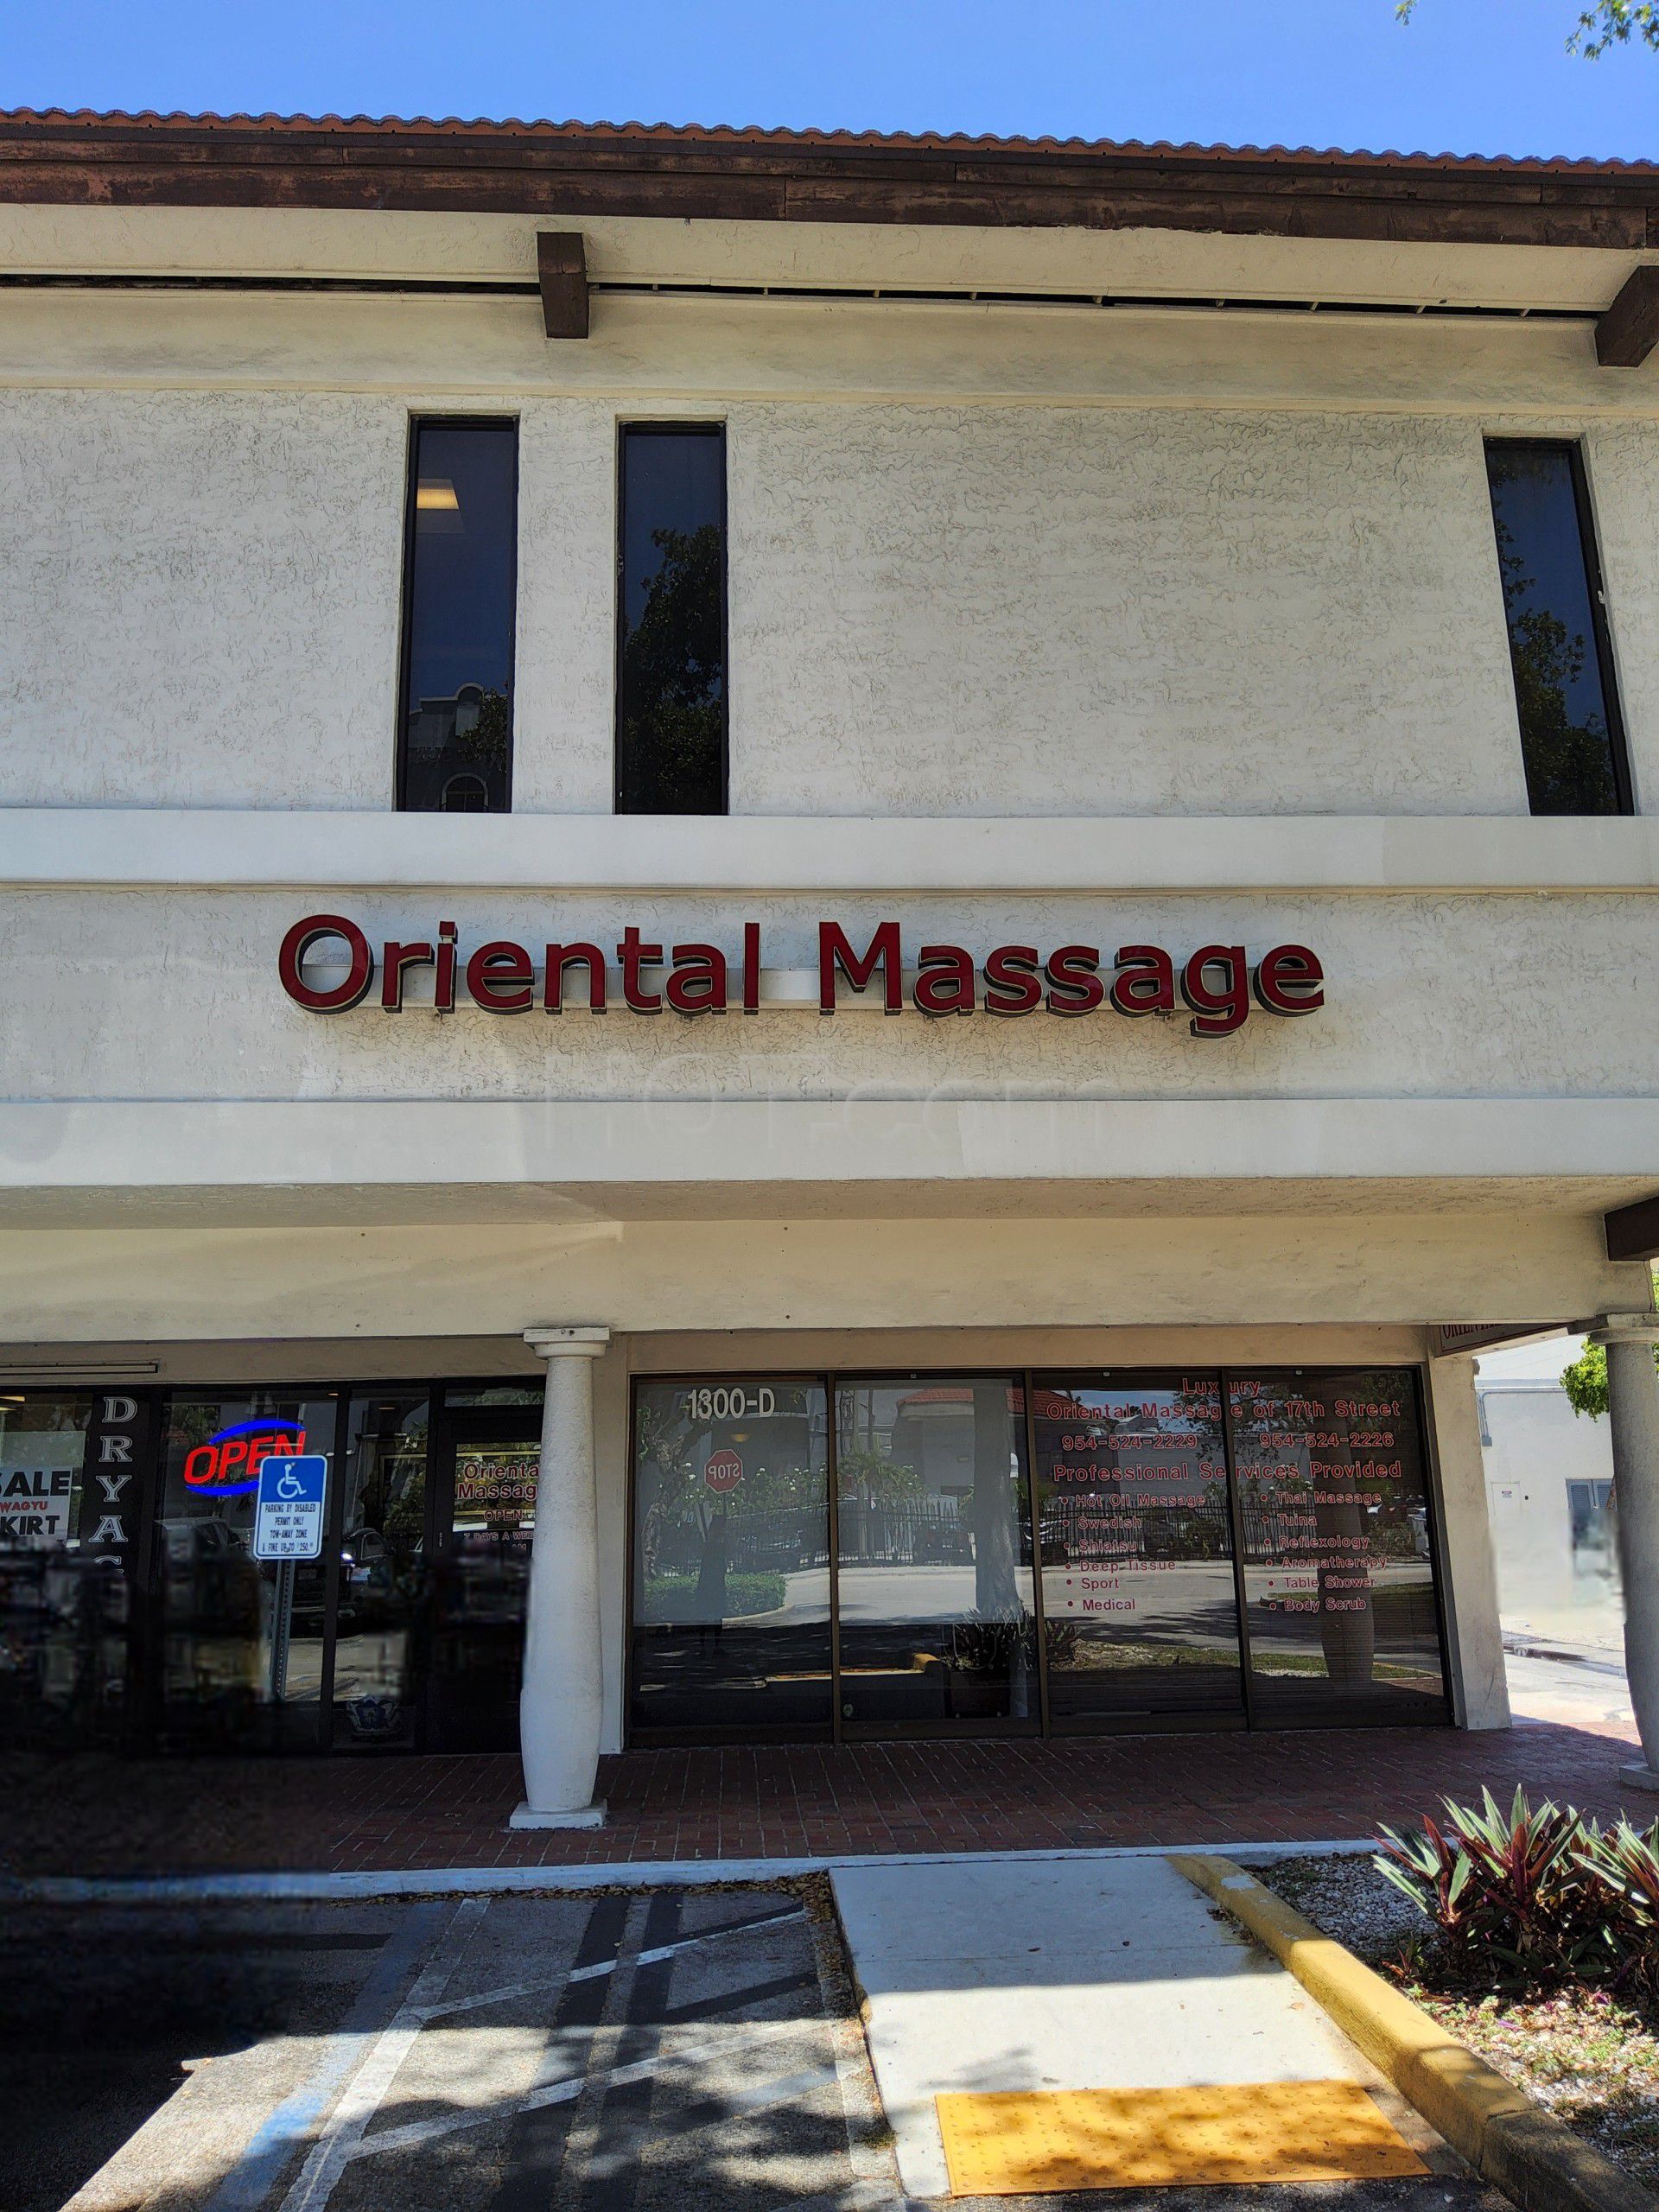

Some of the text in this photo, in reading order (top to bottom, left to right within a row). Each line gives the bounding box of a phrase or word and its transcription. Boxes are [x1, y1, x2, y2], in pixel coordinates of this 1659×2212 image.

[278, 914, 1325, 1038] Oriental Massage
[688, 1388, 775, 1419] 1300-D
[1046, 1402, 1132, 1420] Oriental
[1253, 1401, 1275, 1418] of
[1284, 1400, 1325, 1417] 17th
[1334, 1400, 1401, 1417] Street
[1061, 1433, 1198, 1452] 954-524-2229
[1259, 1432, 1395, 1448] 954-524-2226
[184, 1431, 306, 1484] OPEN
[464, 1463, 539, 1479] Orienta
[1053, 1463, 1189, 1482] Professional
[1309, 1460, 1402, 1478] Provided
[0, 1471, 71, 1497] ALE
[457, 1482, 537, 1501] Massag
[1275, 1491, 1382, 1505] Thai Massage
[1075, 1493, 1206, 1508] Hot Oil Massage
[265, 1503, 284, 1513] PARKING
[295, 1503, 316, 1513] DISABLED
[484, 1509, 524, 1521] OPEN
[275, 1516, 304, 1526] PERMIT ONLY
[1077, 1516, 1142, 1529] Swedish
[1277, 1513, 1318, 1526] Tuina
[296, 1529, 308, 1538] ZONE
[473, 1531, 499, 1541] DAYS
[502, 1531, 510, 1541] A
[512, 1530, 534, 1539] WEE
[1079, 1539, 1138, 1552] Shiatsu
[1278, 1535, 1370, 1549] Reflexology
[1080, 1559, 1176, 1573] Deep Tissue
[1281, 1555, 1387, 1570] Aromatherapy
[1081, 1578, 1119, 1592] Sport
[1283, 1575, 1376, 1588] Table Shower
[1083, 1599, 1135, 1611] Medical
[1284, 1597, 1366, 1613] Body Scrub
